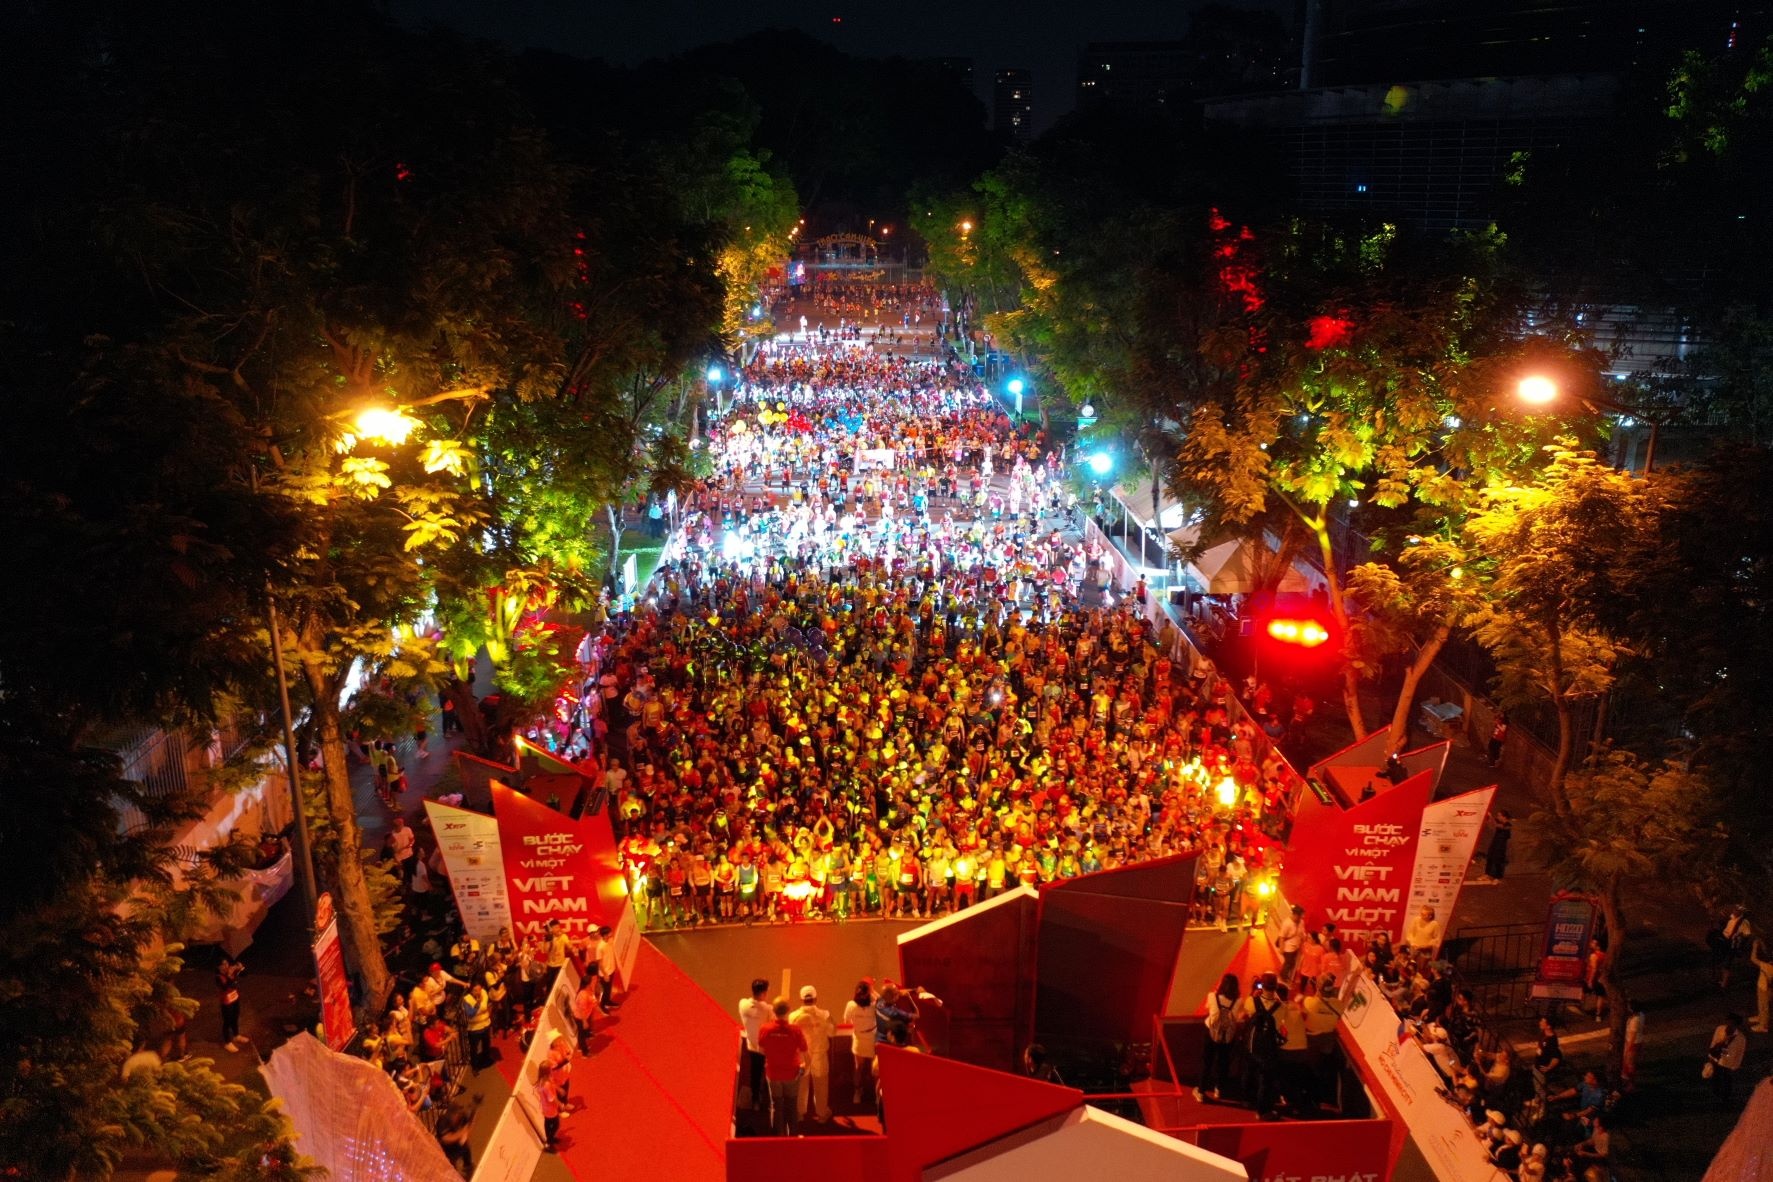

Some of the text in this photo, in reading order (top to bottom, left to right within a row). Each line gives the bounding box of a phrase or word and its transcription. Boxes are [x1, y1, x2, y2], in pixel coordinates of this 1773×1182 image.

[1354, 824, 1402, 835] BƯỚC
[523, 834, 574, 847] BƯỚC
[1364, 836, 1410, 848] CHẠY
[536, 844, 583, 857] CHẠY
[1360, 848, 1390, 858] MỘT
[535, 858, 566, 870] MỘT
[1334, 861, 1394, 885] VIỆT
[513, 872, 574, 896] VIỆT
[1337, 888, 1400, 902] NAM
[522, 897, 587, 914] NAM
[1326, 906, 1398, 926] VƯỢT
